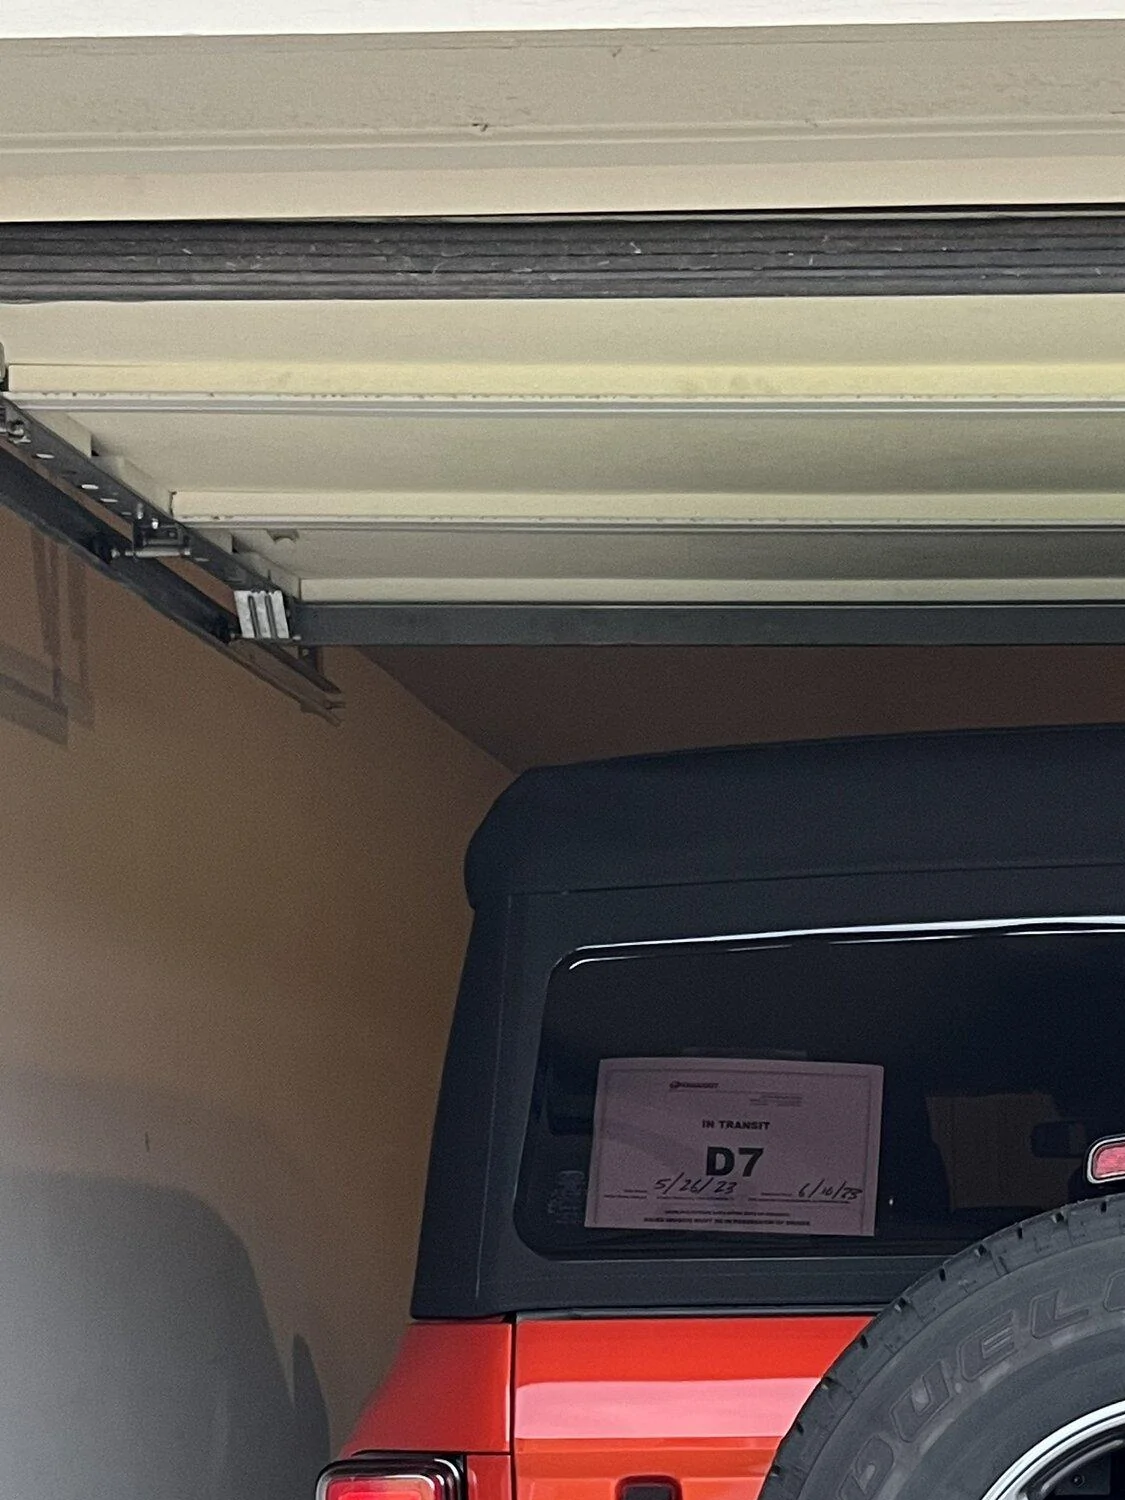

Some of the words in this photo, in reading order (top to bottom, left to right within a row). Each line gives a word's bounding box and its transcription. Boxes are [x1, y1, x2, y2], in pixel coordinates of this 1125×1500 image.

[702, 1119, 714, 1129] IN
[719, 1120, 770, 1131] TRANSIT
[705, 1146, 765, 1178] D7
